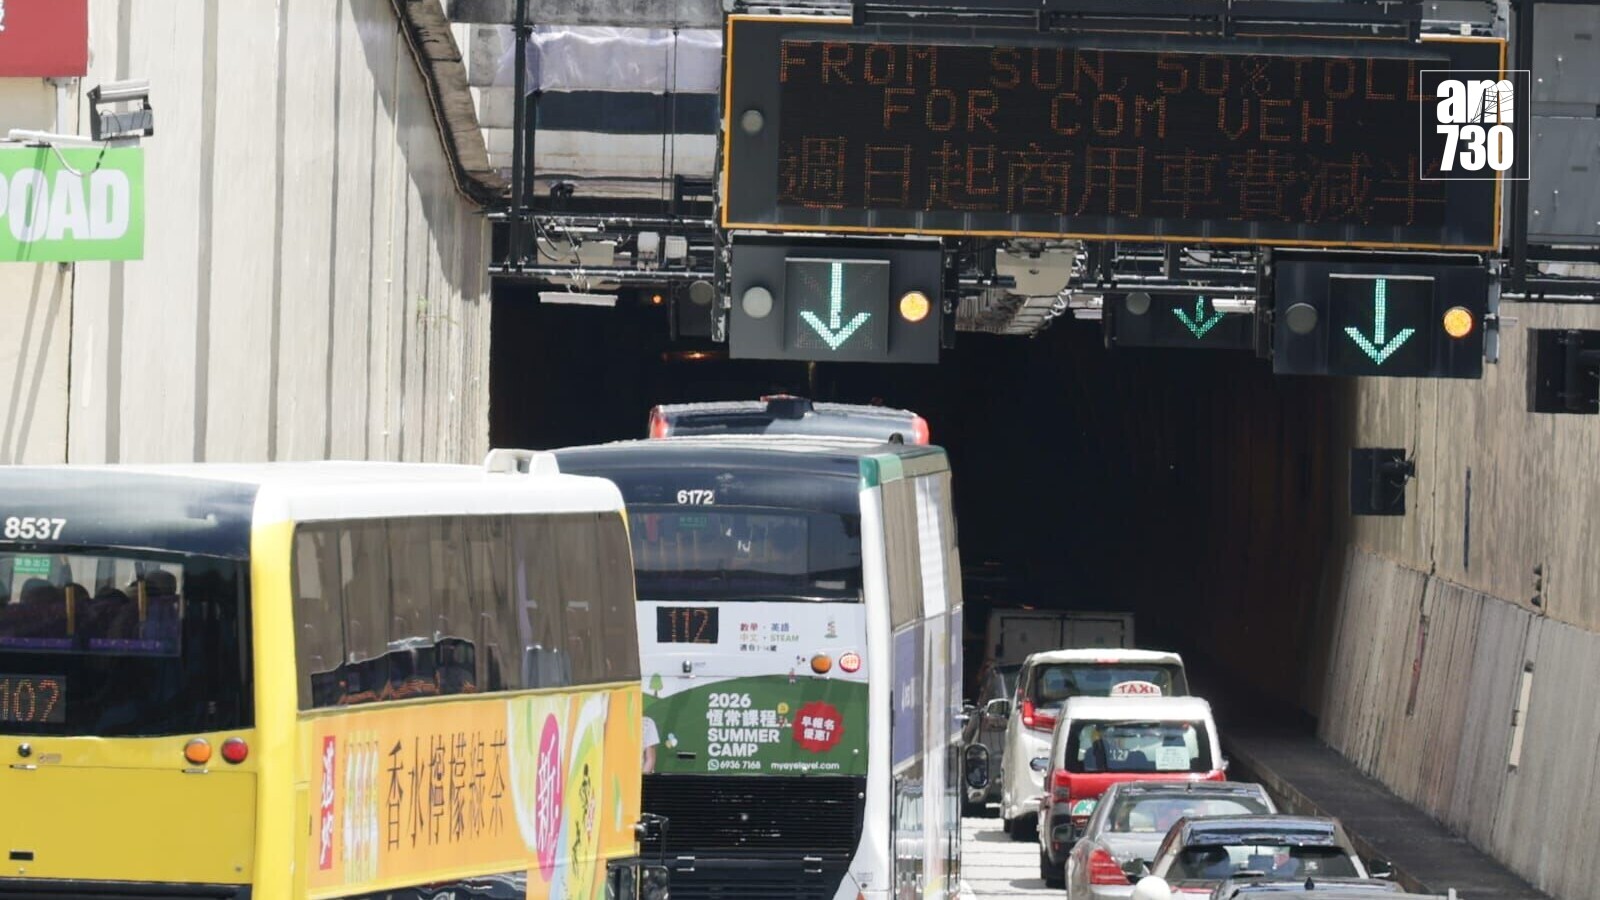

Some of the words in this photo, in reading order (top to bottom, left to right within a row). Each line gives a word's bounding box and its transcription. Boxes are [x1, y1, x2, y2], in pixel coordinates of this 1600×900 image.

[779, 40, 938, 85] FROM
[884, 88, 999, 132] FOR
[1051, 92, 1166, 139] COM
[1217, 98, 1333, 143] VEH
[0, 167, 130, 242] OAD
[677, 490, 713, 504] 6172
[4, 516, 67, 540] 8537
[668, 609, 709, 643] 112
[0, 679, 60, 721] 107
[708, 693, 752, 708] 2026
[1119, 683, 1154, 694] TAXI
[707, 728, 780, 743] SUMMER
[708, 743, 758, 757] CAMP
